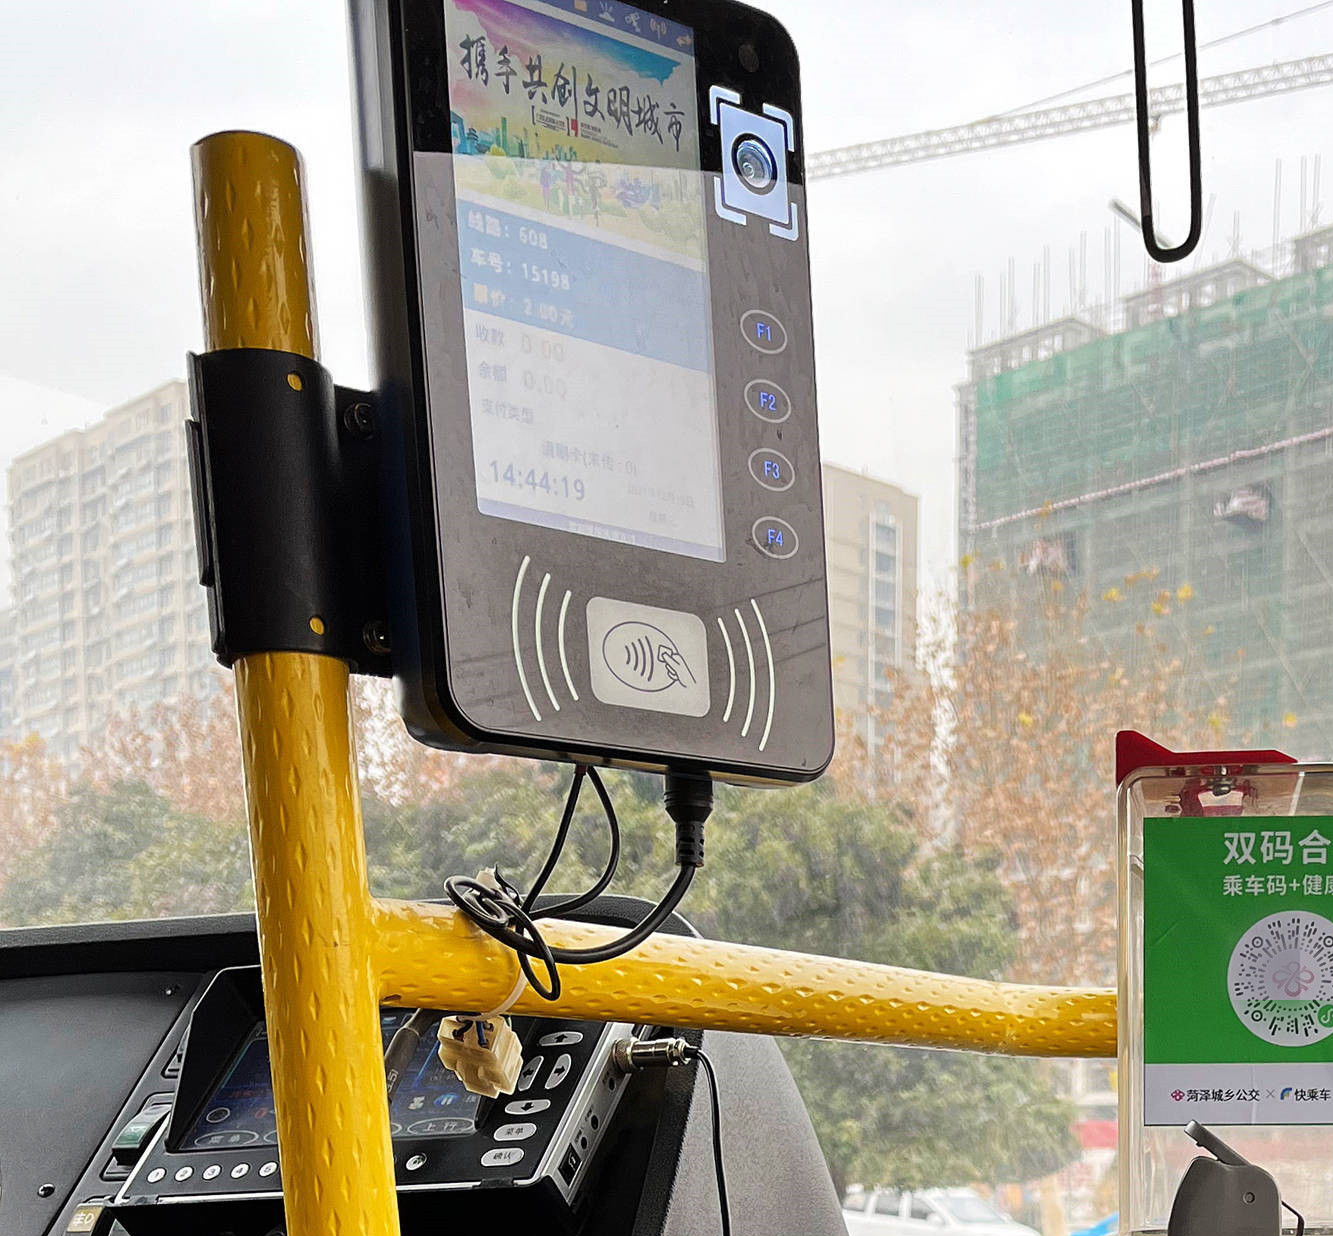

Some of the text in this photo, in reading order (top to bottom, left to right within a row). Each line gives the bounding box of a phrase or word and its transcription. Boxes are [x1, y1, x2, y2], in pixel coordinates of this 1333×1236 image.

[459, 32, 685, 152] 携手共创文明城市
[755, 322, 773, 342] F1
[759, 391, 777, 412] F2
[763, 460, 781, 480] F3
[488, 459, 586, 502] 14:44:19
[767, 528, 785, 548] F4
[1186, 1087, 1260, 1102] 菏泽城乡公交
[1294, 1087, 1332, 1102] 快乘车
